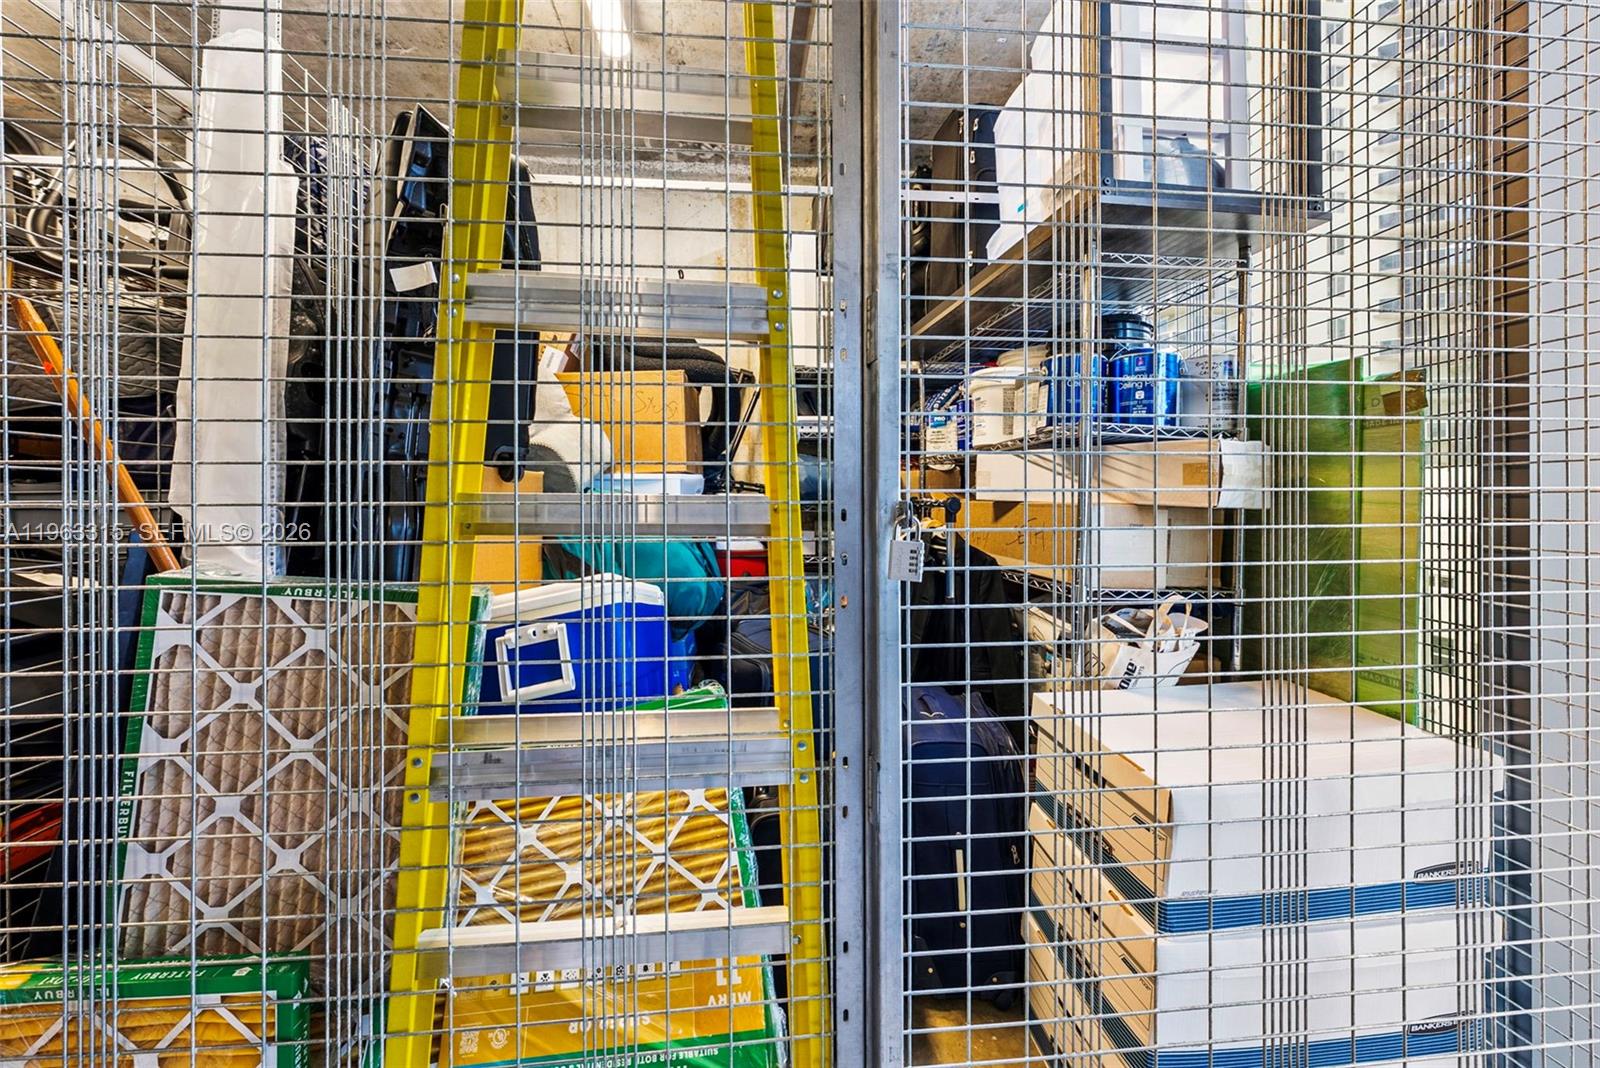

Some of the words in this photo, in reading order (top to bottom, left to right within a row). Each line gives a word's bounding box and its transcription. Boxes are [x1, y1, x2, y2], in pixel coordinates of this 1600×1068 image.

[1122, 371, 1157, 383] Premiu
[283, 587, 360, 599] ILTRBUY
[1113, 660, 1137, 690] one
[118, 770, 135, 845] FILTERBUY
[716, 956, 742, 986] 11
[34, 987, 121, 1000] ILRBUY
[708, 991, 751, 1008] MERV
[568, 1013, 651, 1034] SUPEROR
[1410, 1019, 1453, 1032] BANKERS
[660, 1052, 676, 1062] FOR
[679, 1047, 719, 1060] SUITABLE
